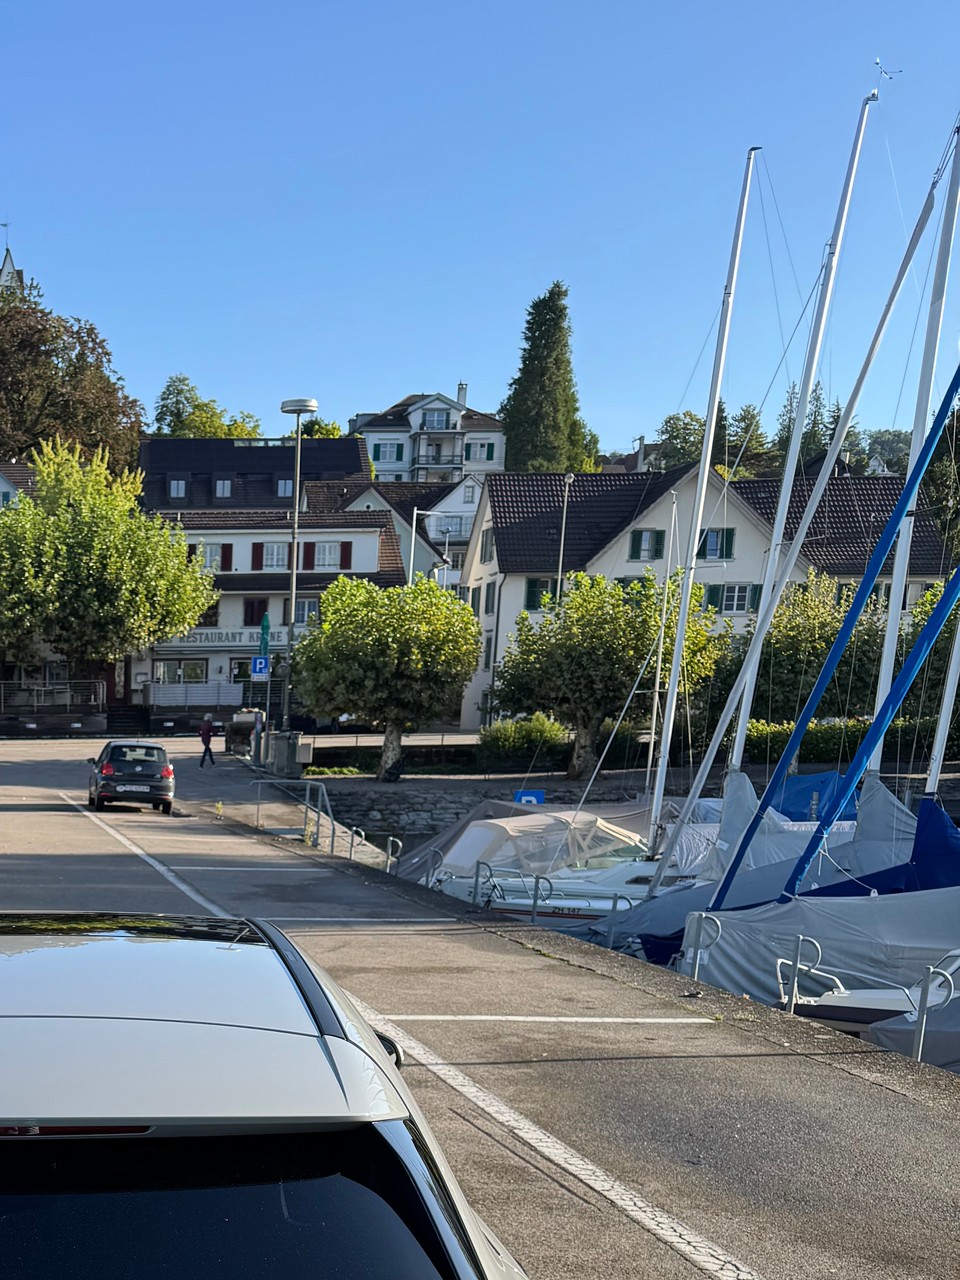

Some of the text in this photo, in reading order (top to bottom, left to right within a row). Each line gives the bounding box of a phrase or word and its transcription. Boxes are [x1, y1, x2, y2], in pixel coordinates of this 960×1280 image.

[179, 631, 244, 644] RESTAURANT
[249, 631, 282, 643] KRNE
[256, 659, 266, 672] P
